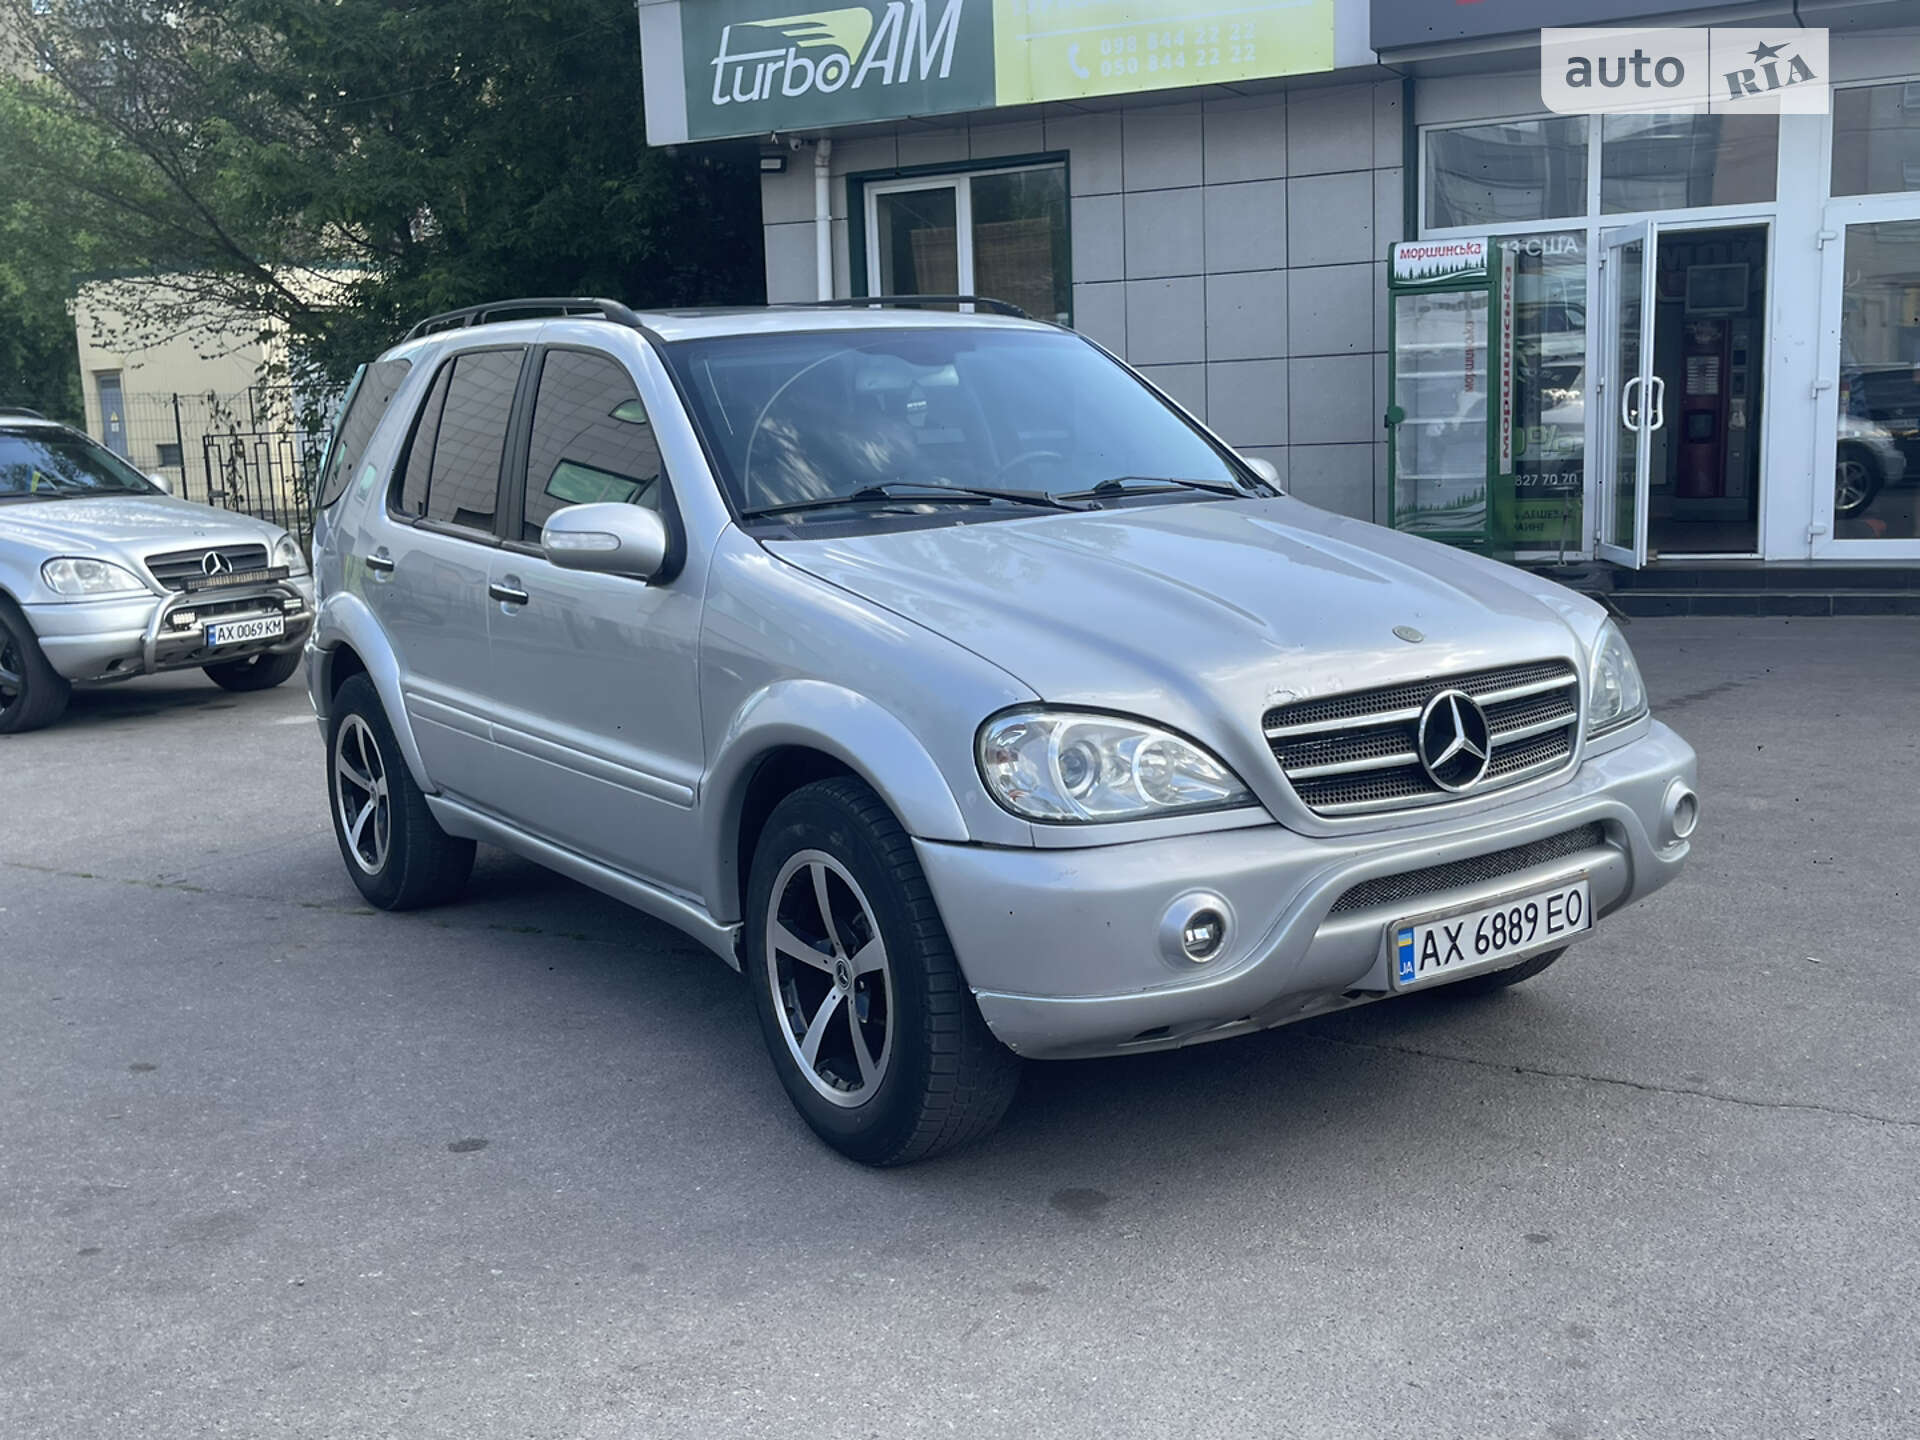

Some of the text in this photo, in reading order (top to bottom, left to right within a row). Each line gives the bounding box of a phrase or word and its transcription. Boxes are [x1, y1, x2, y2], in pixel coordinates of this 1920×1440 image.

[1195, 25, 1219, 45] 22
[1230, 23, 1256, 41] 22
[1101, 43, 1256, 77] 050 844 22 22
[1400, 242, 1481, 261] моршинська
[1526, 235, 1578, 257] США
[218, 618, 281, 641] AX 0069 KM
[1420, 922, 1464, 971] AX
[1475, 903, 1538, 955] 6889
[1547, 889, 1583, 935] EO
